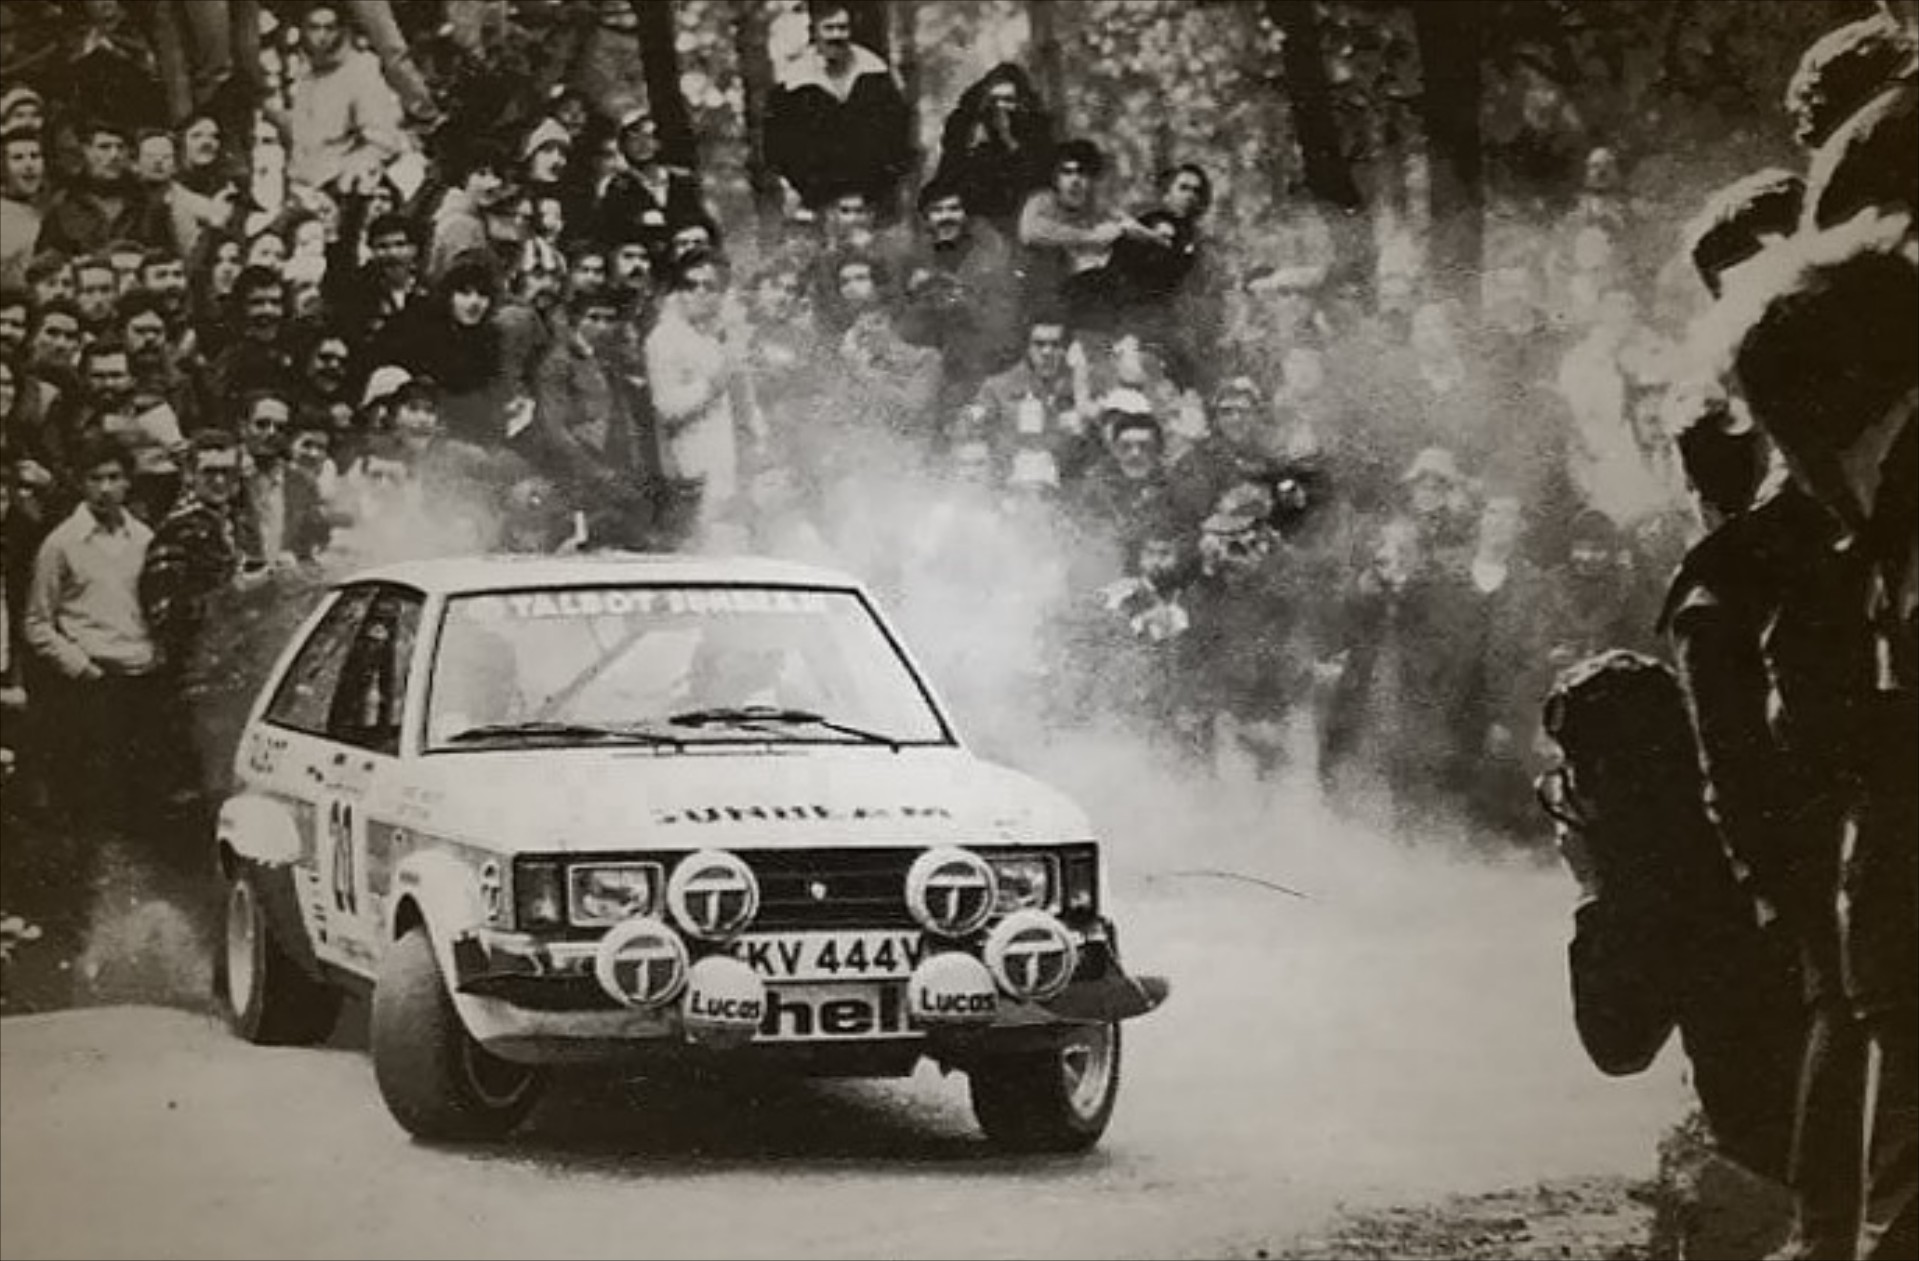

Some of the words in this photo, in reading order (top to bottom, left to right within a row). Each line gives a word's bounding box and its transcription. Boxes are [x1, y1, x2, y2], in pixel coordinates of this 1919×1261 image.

[510, 591, 653, 615] TALBOT
[815, 937, 925, 974] 444V
[691, 989, 761, 1019] Lucas
[759, 985, 917, 1036] hel
[921, 986, 995, 1013] Lucas
